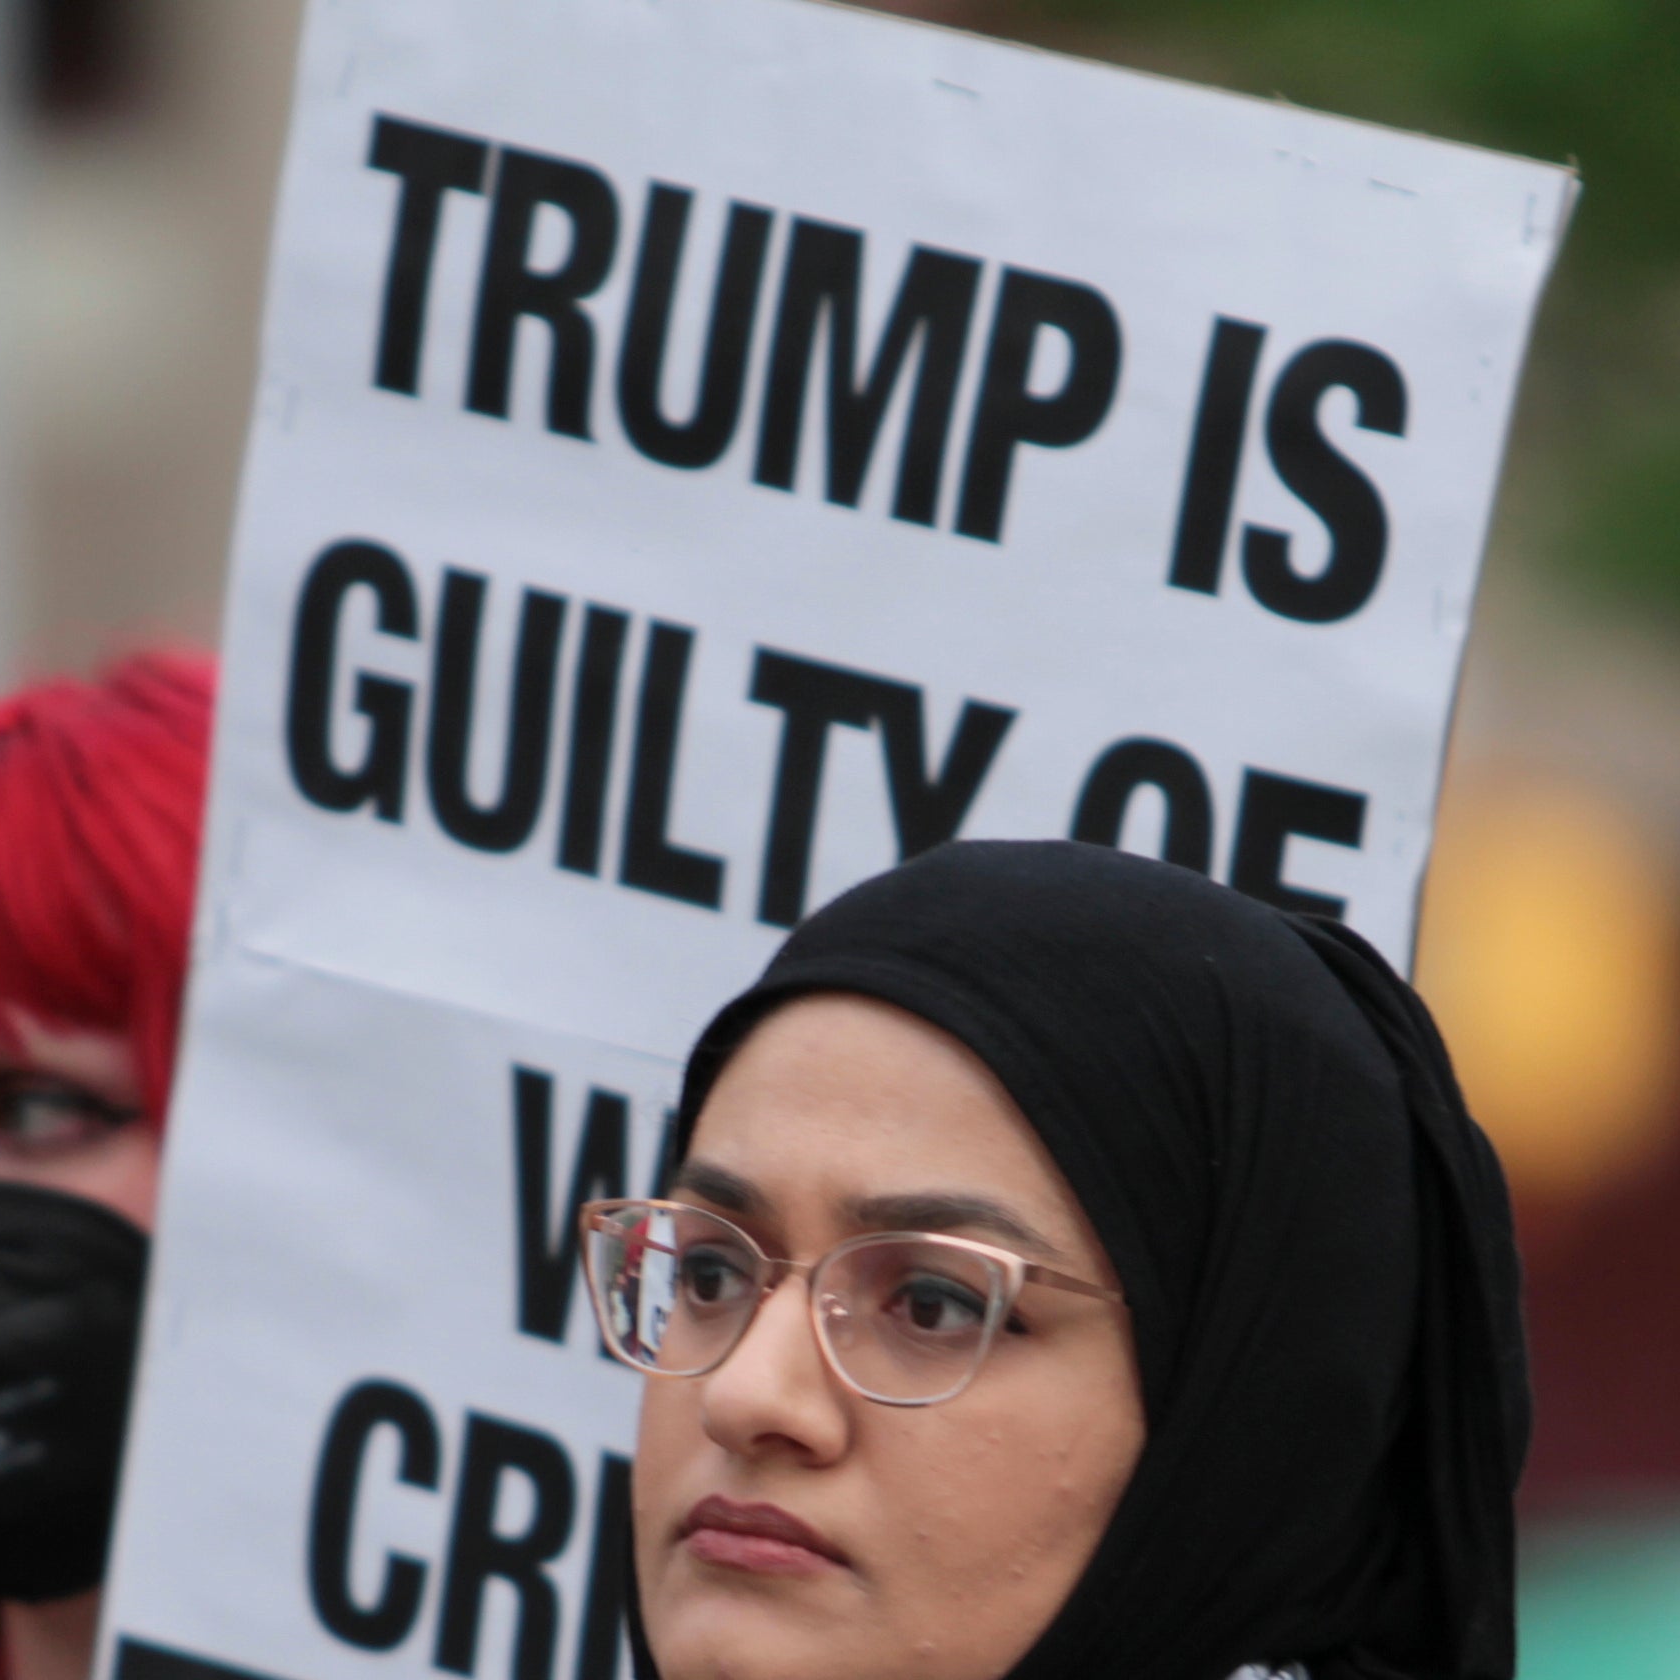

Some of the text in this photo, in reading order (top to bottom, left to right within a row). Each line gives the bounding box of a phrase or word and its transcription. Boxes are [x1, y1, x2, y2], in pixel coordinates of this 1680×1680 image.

[365, 112, 1409, 625] TRUMP IS
[283, 538, 1020, 929] GUILTY
